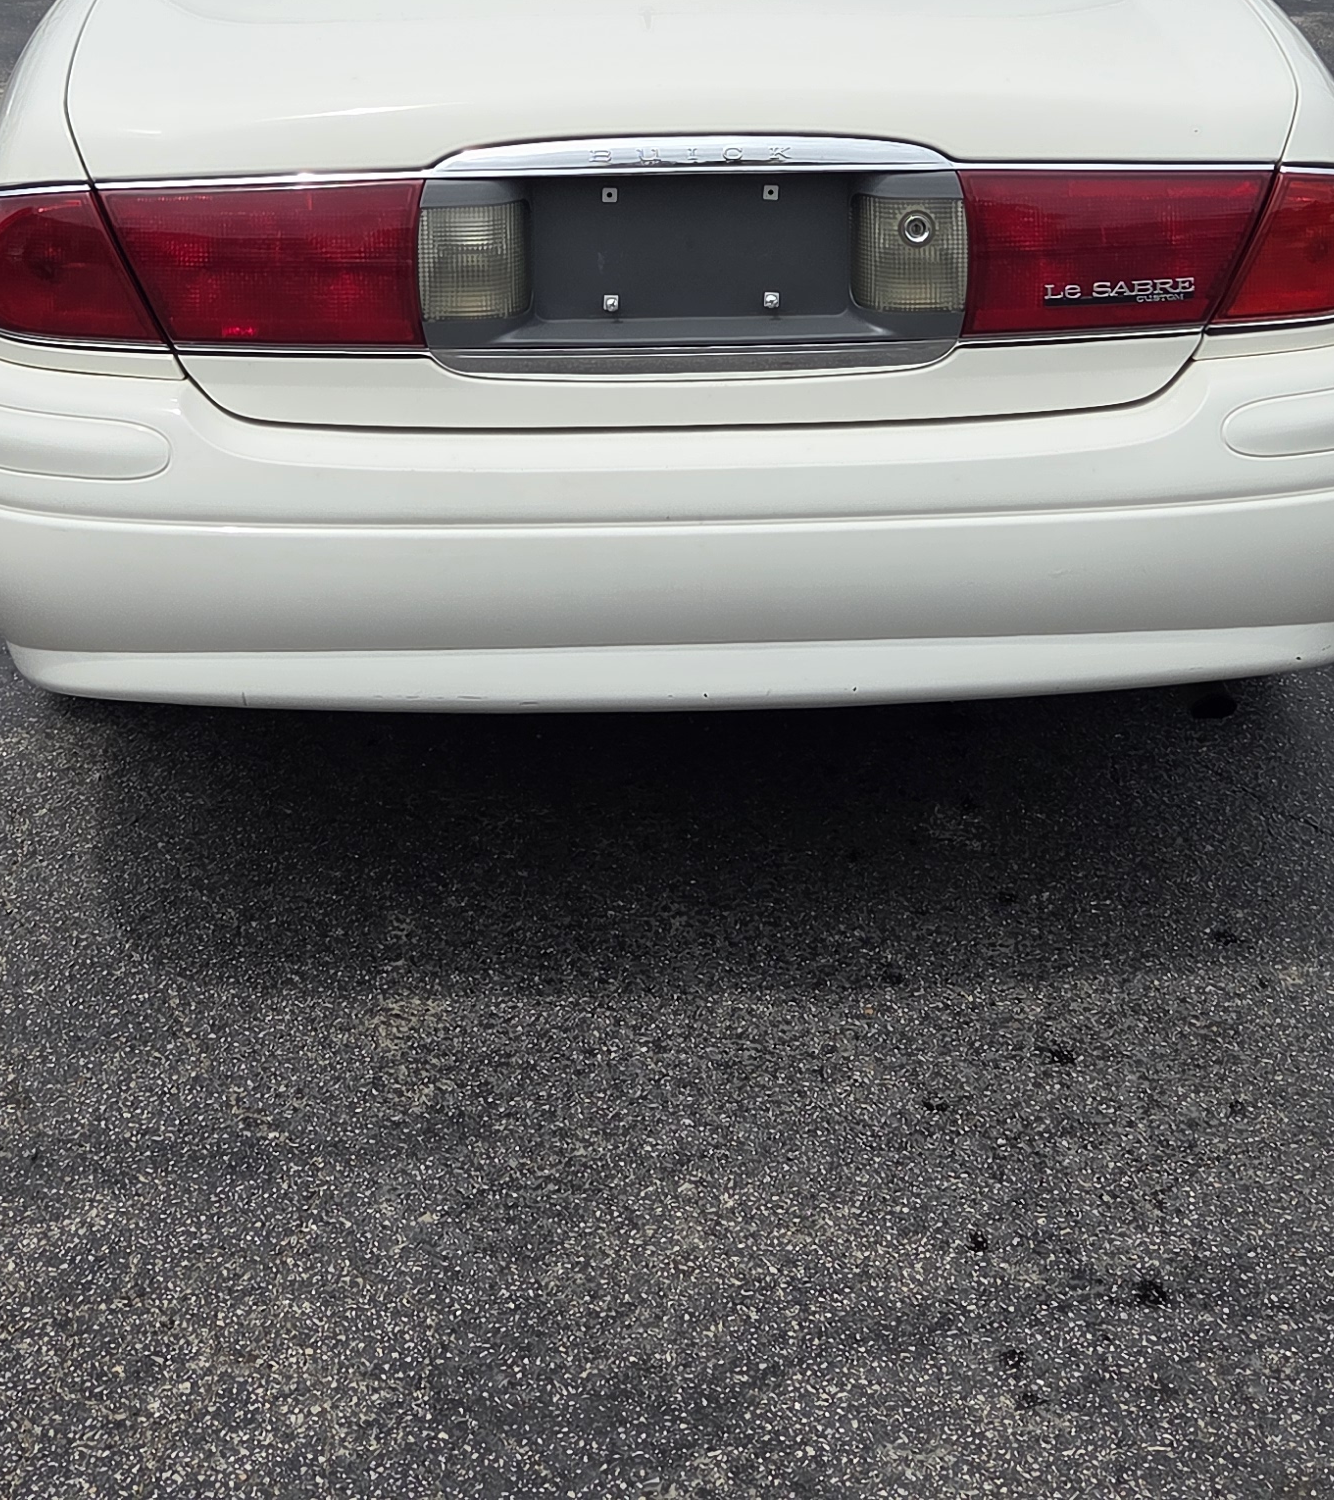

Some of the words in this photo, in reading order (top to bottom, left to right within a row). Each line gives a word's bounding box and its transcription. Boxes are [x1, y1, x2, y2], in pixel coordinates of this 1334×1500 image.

[587, 147, 792, 165] BUICK
[1044, 284, 1082, 300] Le
[1092, 276, 1196, 298] SABRE
[1135, 293, 1185, 303] CUSTOM
